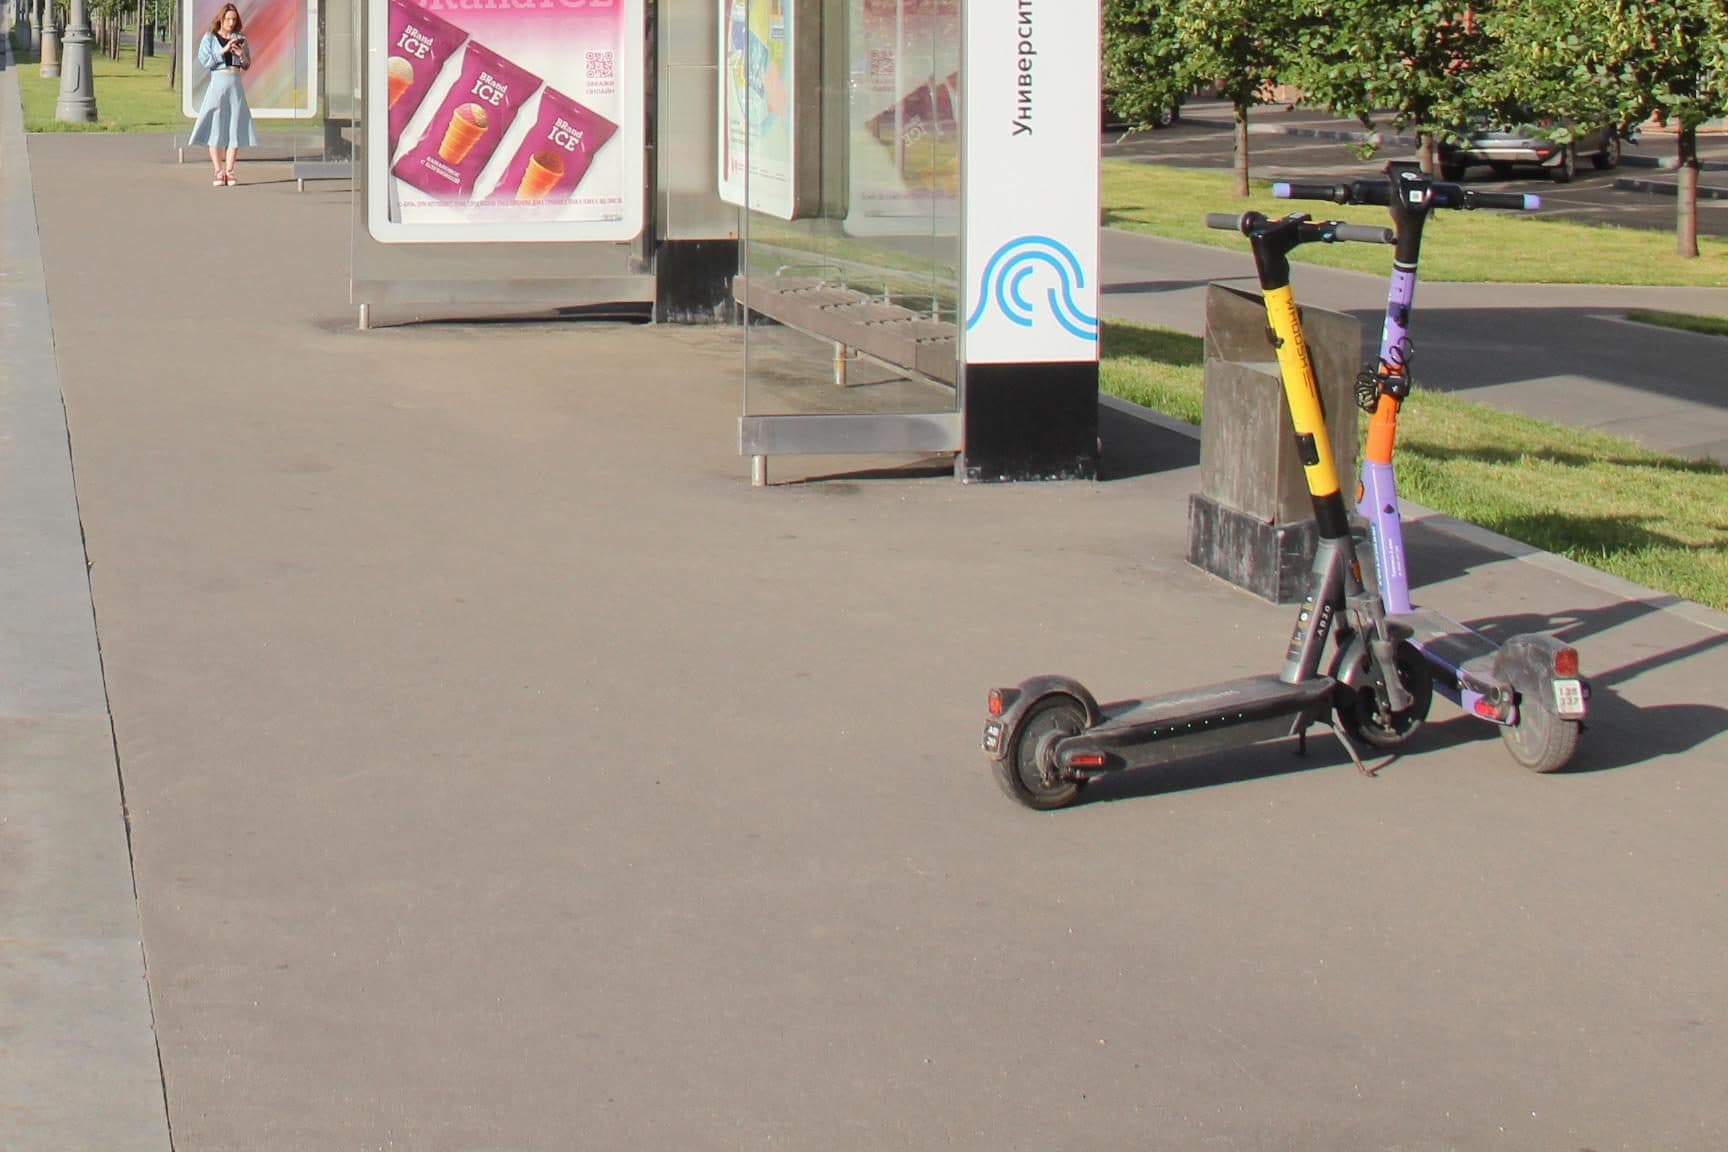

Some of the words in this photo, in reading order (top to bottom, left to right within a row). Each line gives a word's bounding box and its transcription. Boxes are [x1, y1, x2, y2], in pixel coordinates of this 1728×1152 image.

[397, 34, 429, 59] ICE
[471, 80, 504, 106] ICE
[547, 126, 579, 151] ICE
